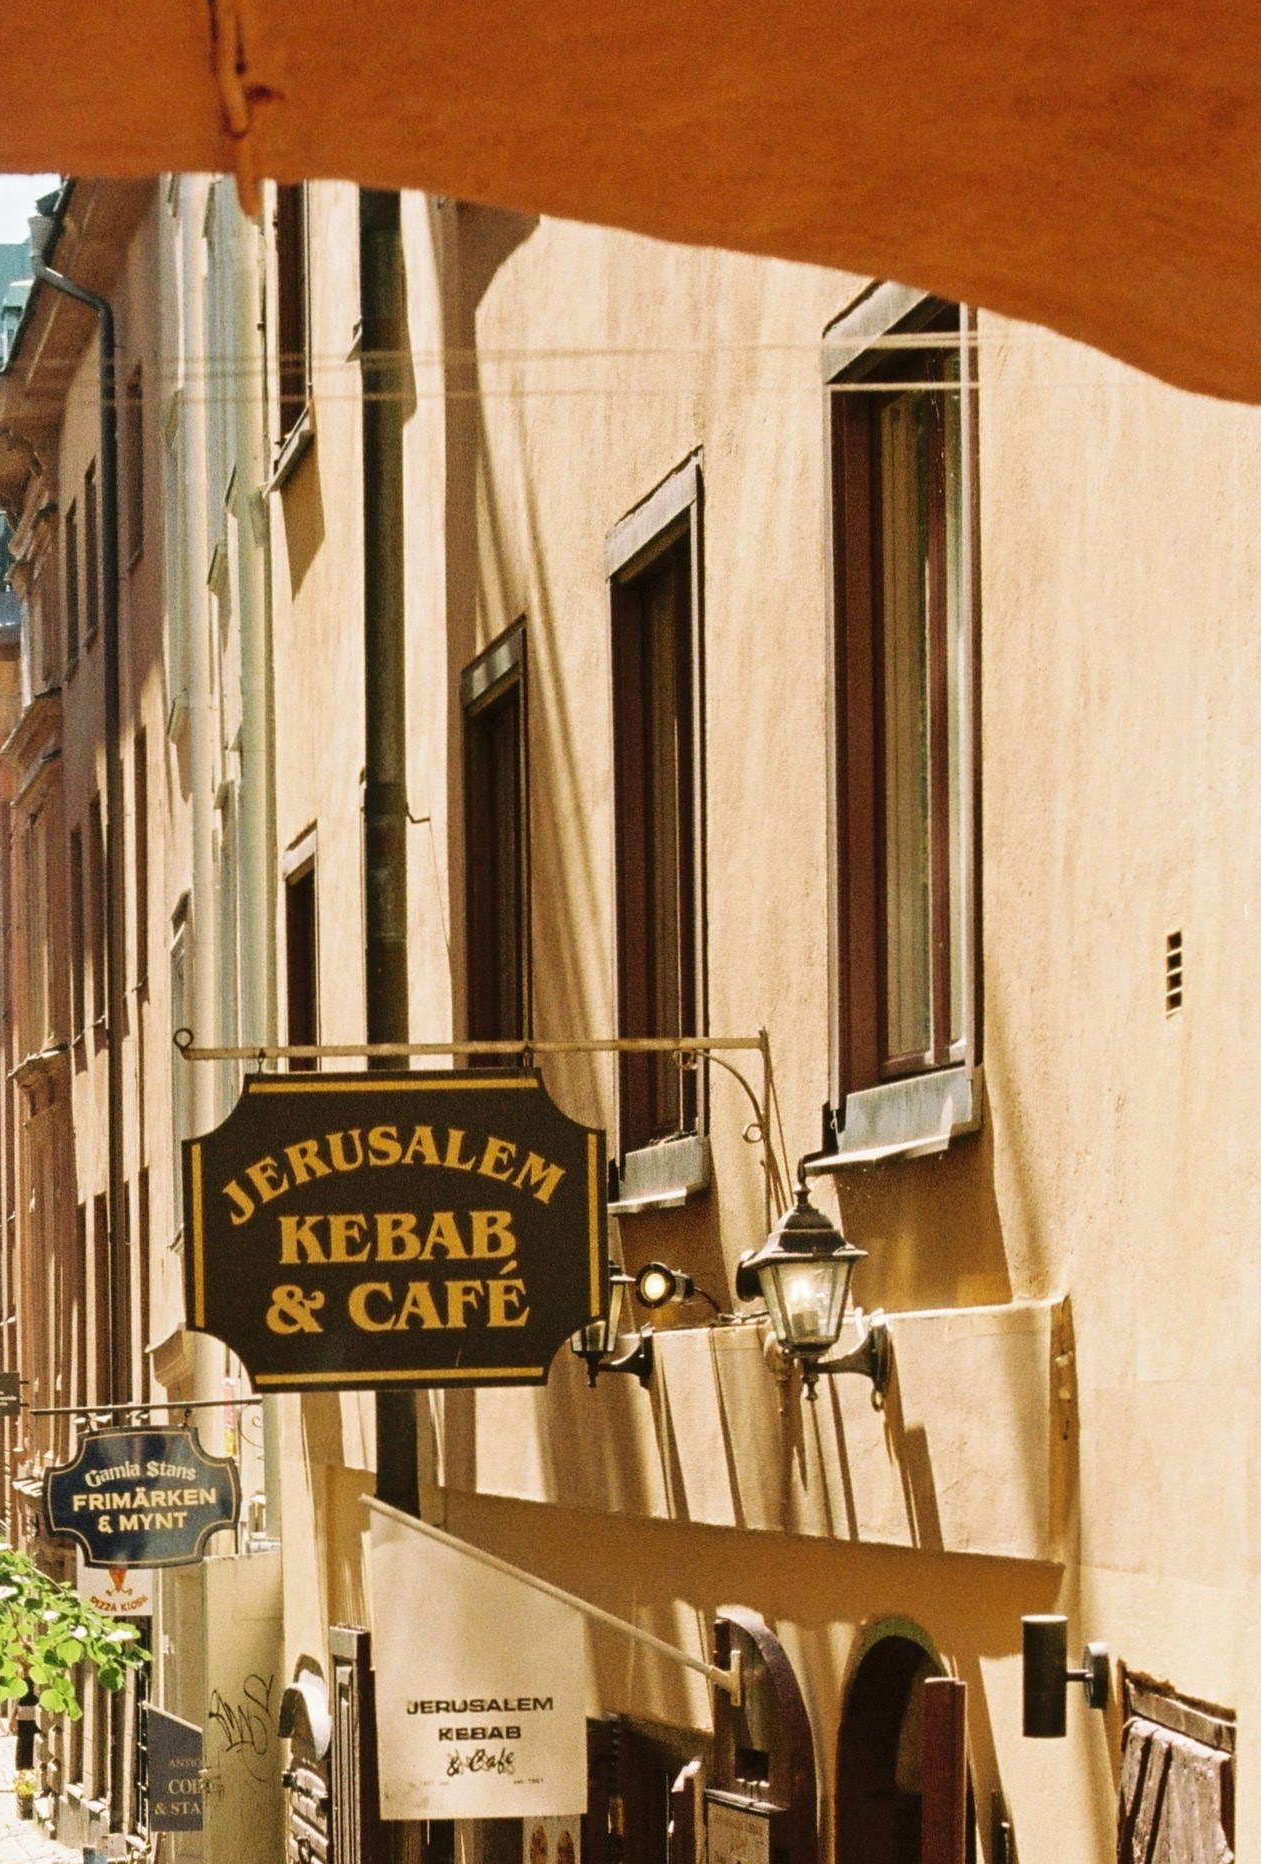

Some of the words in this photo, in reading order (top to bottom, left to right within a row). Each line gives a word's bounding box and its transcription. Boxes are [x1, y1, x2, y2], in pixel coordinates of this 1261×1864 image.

[221, 1125, 566, 1226] JERUSALEM
[278, 1210, 518, 1265] KEBAB
[266, 1284, 325, 1335] &
[348, 1260, 531, 1333] CAFÉ
[84, 1460, 140, 1488] Gamla
[146, 1460, 196, 1481] Stans
[72, 1487, 217, 1512] FRIMÄRKEN
[97, 1515, 113, 1534] &
[119, 1511, 188, 1532] MYNT
[89, 1596, 117, 1612] PIZZA
[406, 1696, 554, 1715] JERUSALEM
[438, 1726, 522, 1741] KEBAB
[446, 1750, 462, 1777] &
[154, 1802, 167, 1815] &
